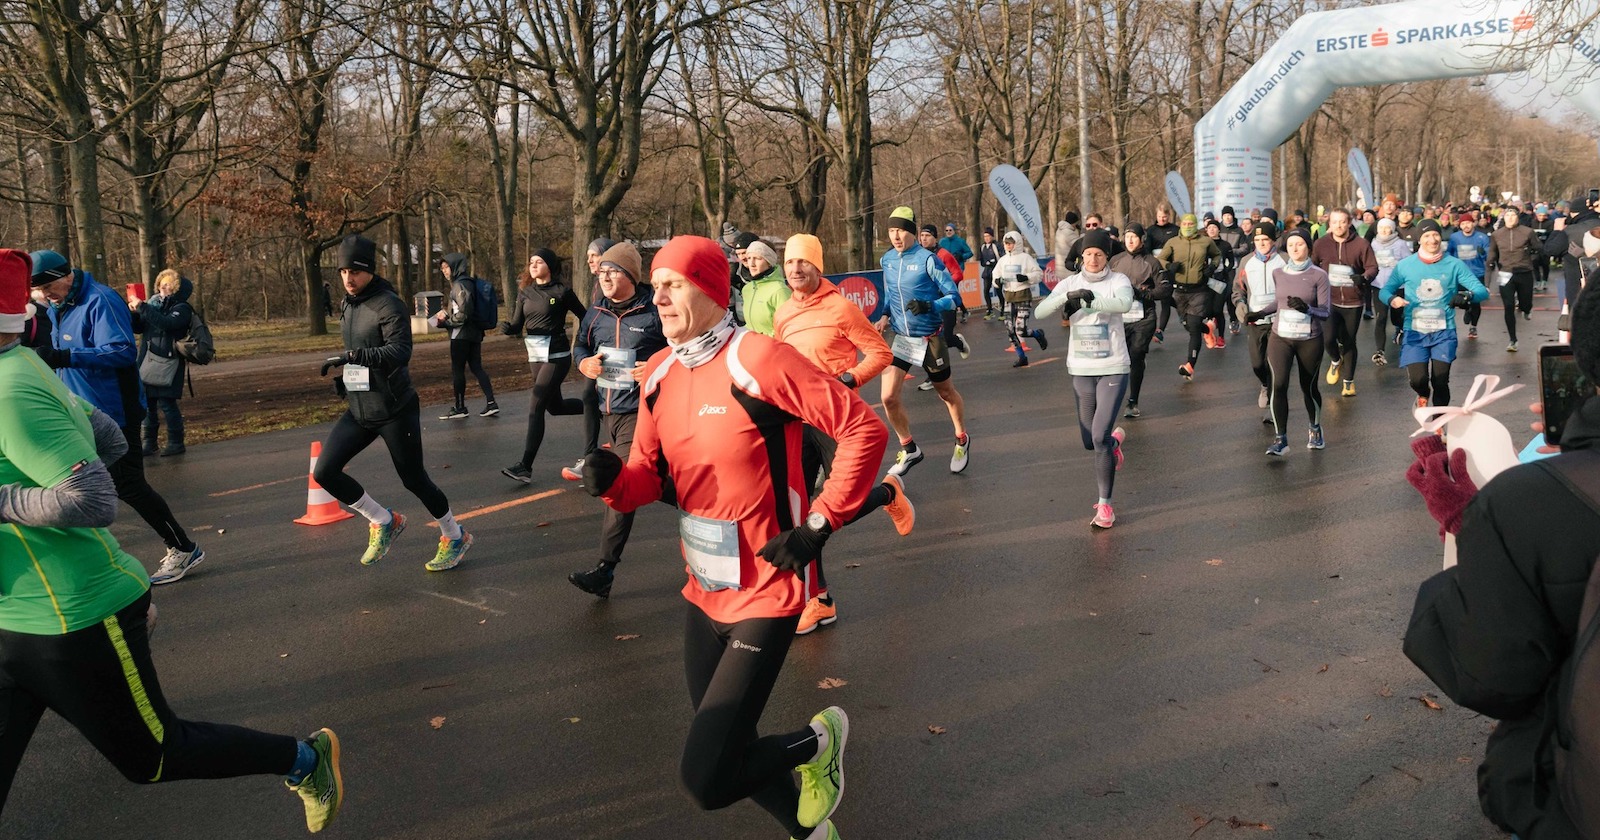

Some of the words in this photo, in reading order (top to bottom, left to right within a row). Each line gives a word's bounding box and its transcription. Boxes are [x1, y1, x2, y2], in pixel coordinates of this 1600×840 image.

[1316, 34, 1368, 53] ERSTE
[1396, 18, 1509, 44] SPARKASSE
[1226, 49, 1306, 131] #glaubandich
